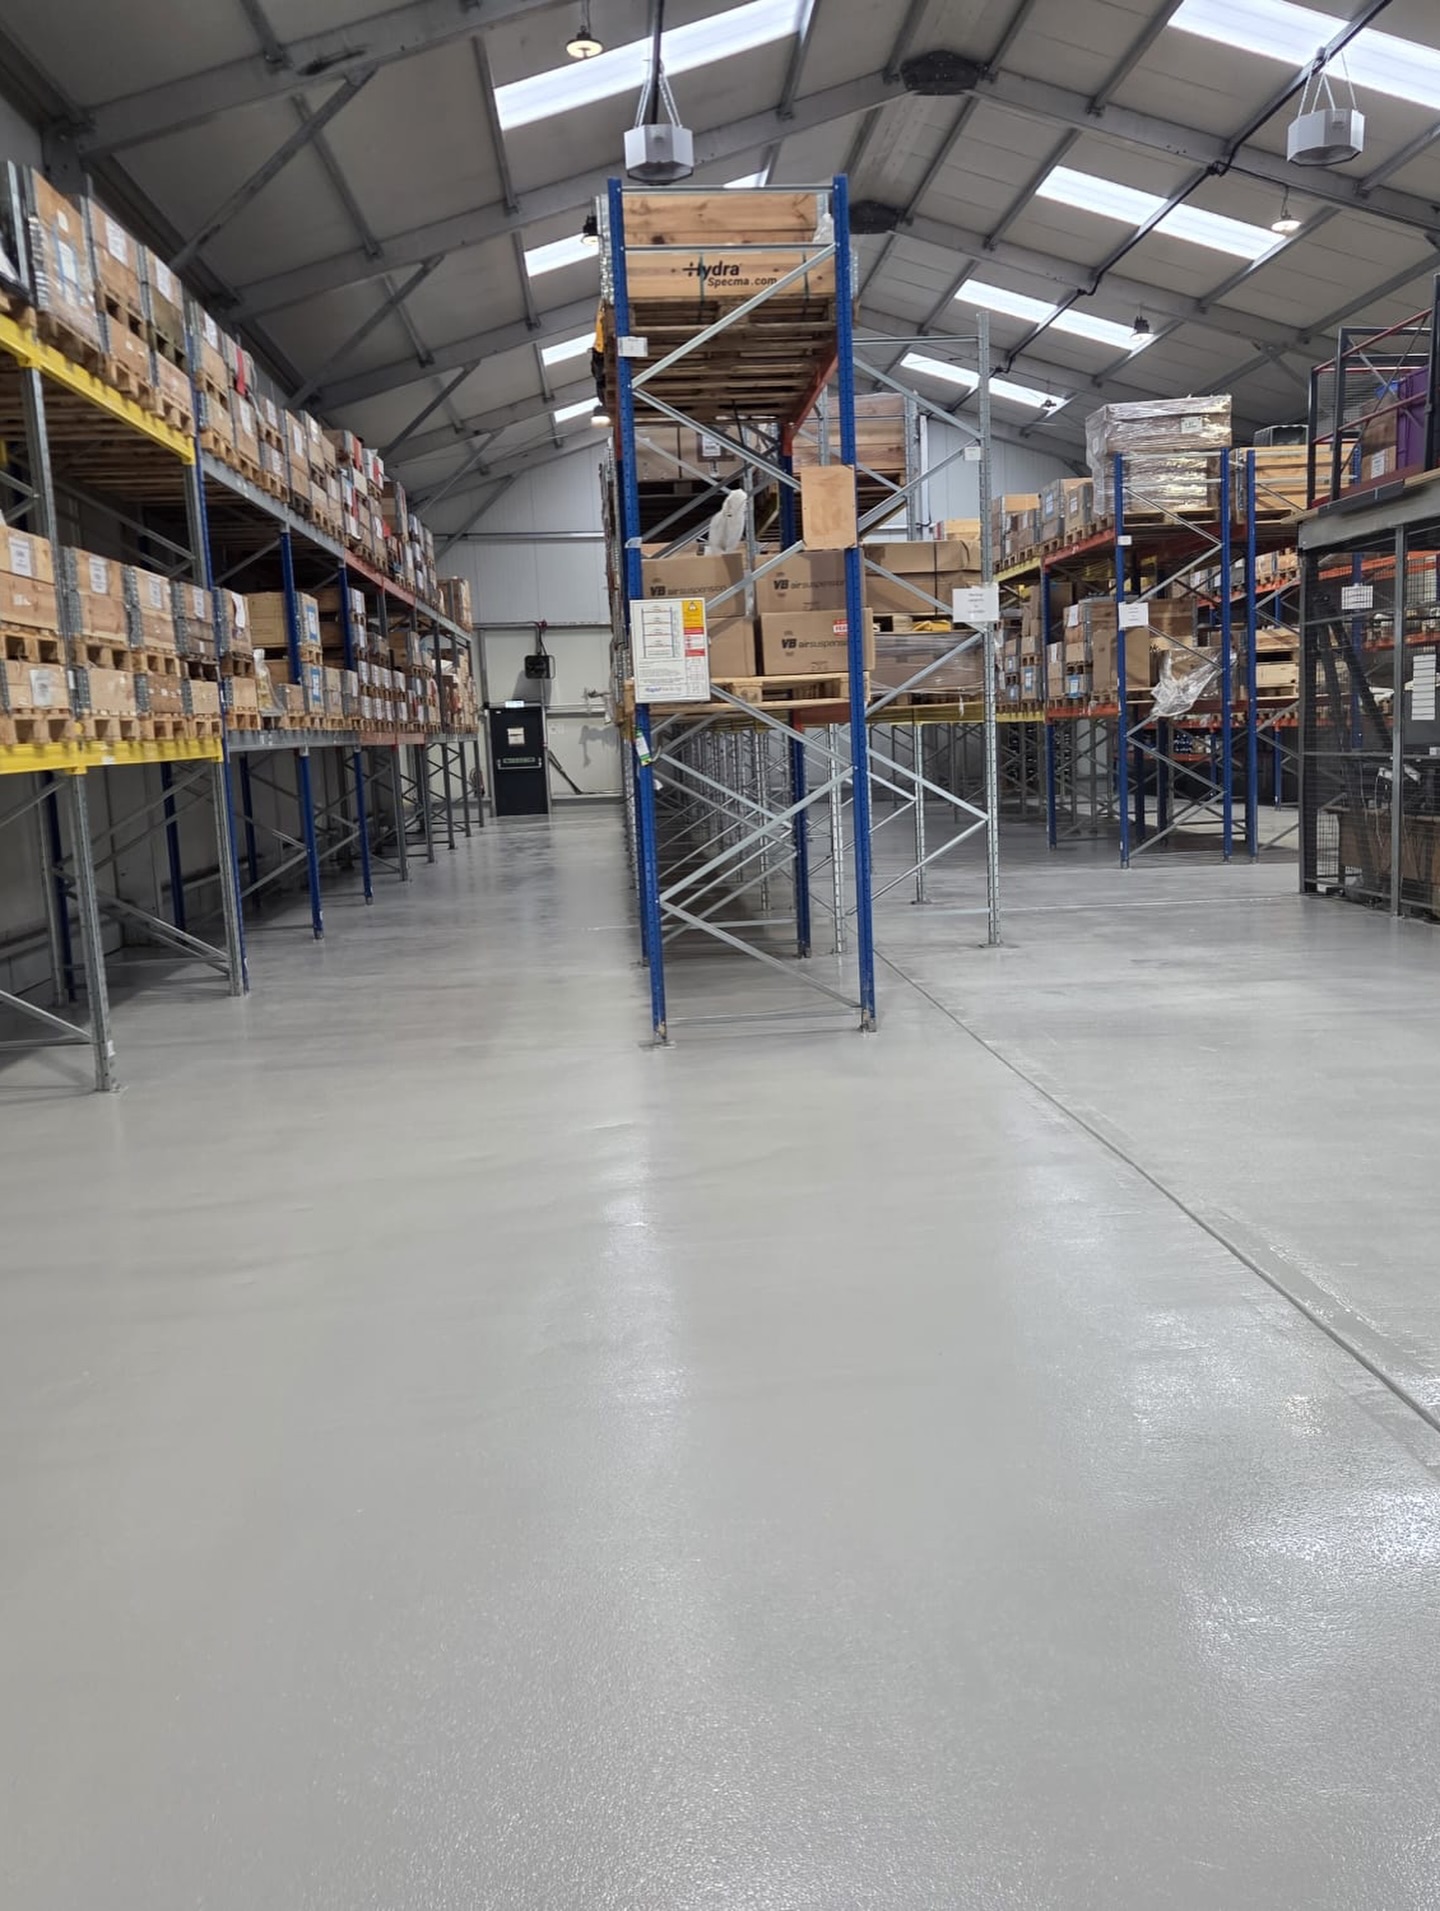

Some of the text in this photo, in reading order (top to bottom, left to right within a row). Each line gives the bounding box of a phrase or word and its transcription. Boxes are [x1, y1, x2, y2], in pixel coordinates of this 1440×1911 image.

[773, 579, 789, 590] VB
[650, 585, 667, 597] VB
[781, 638, 797, 649] VB
